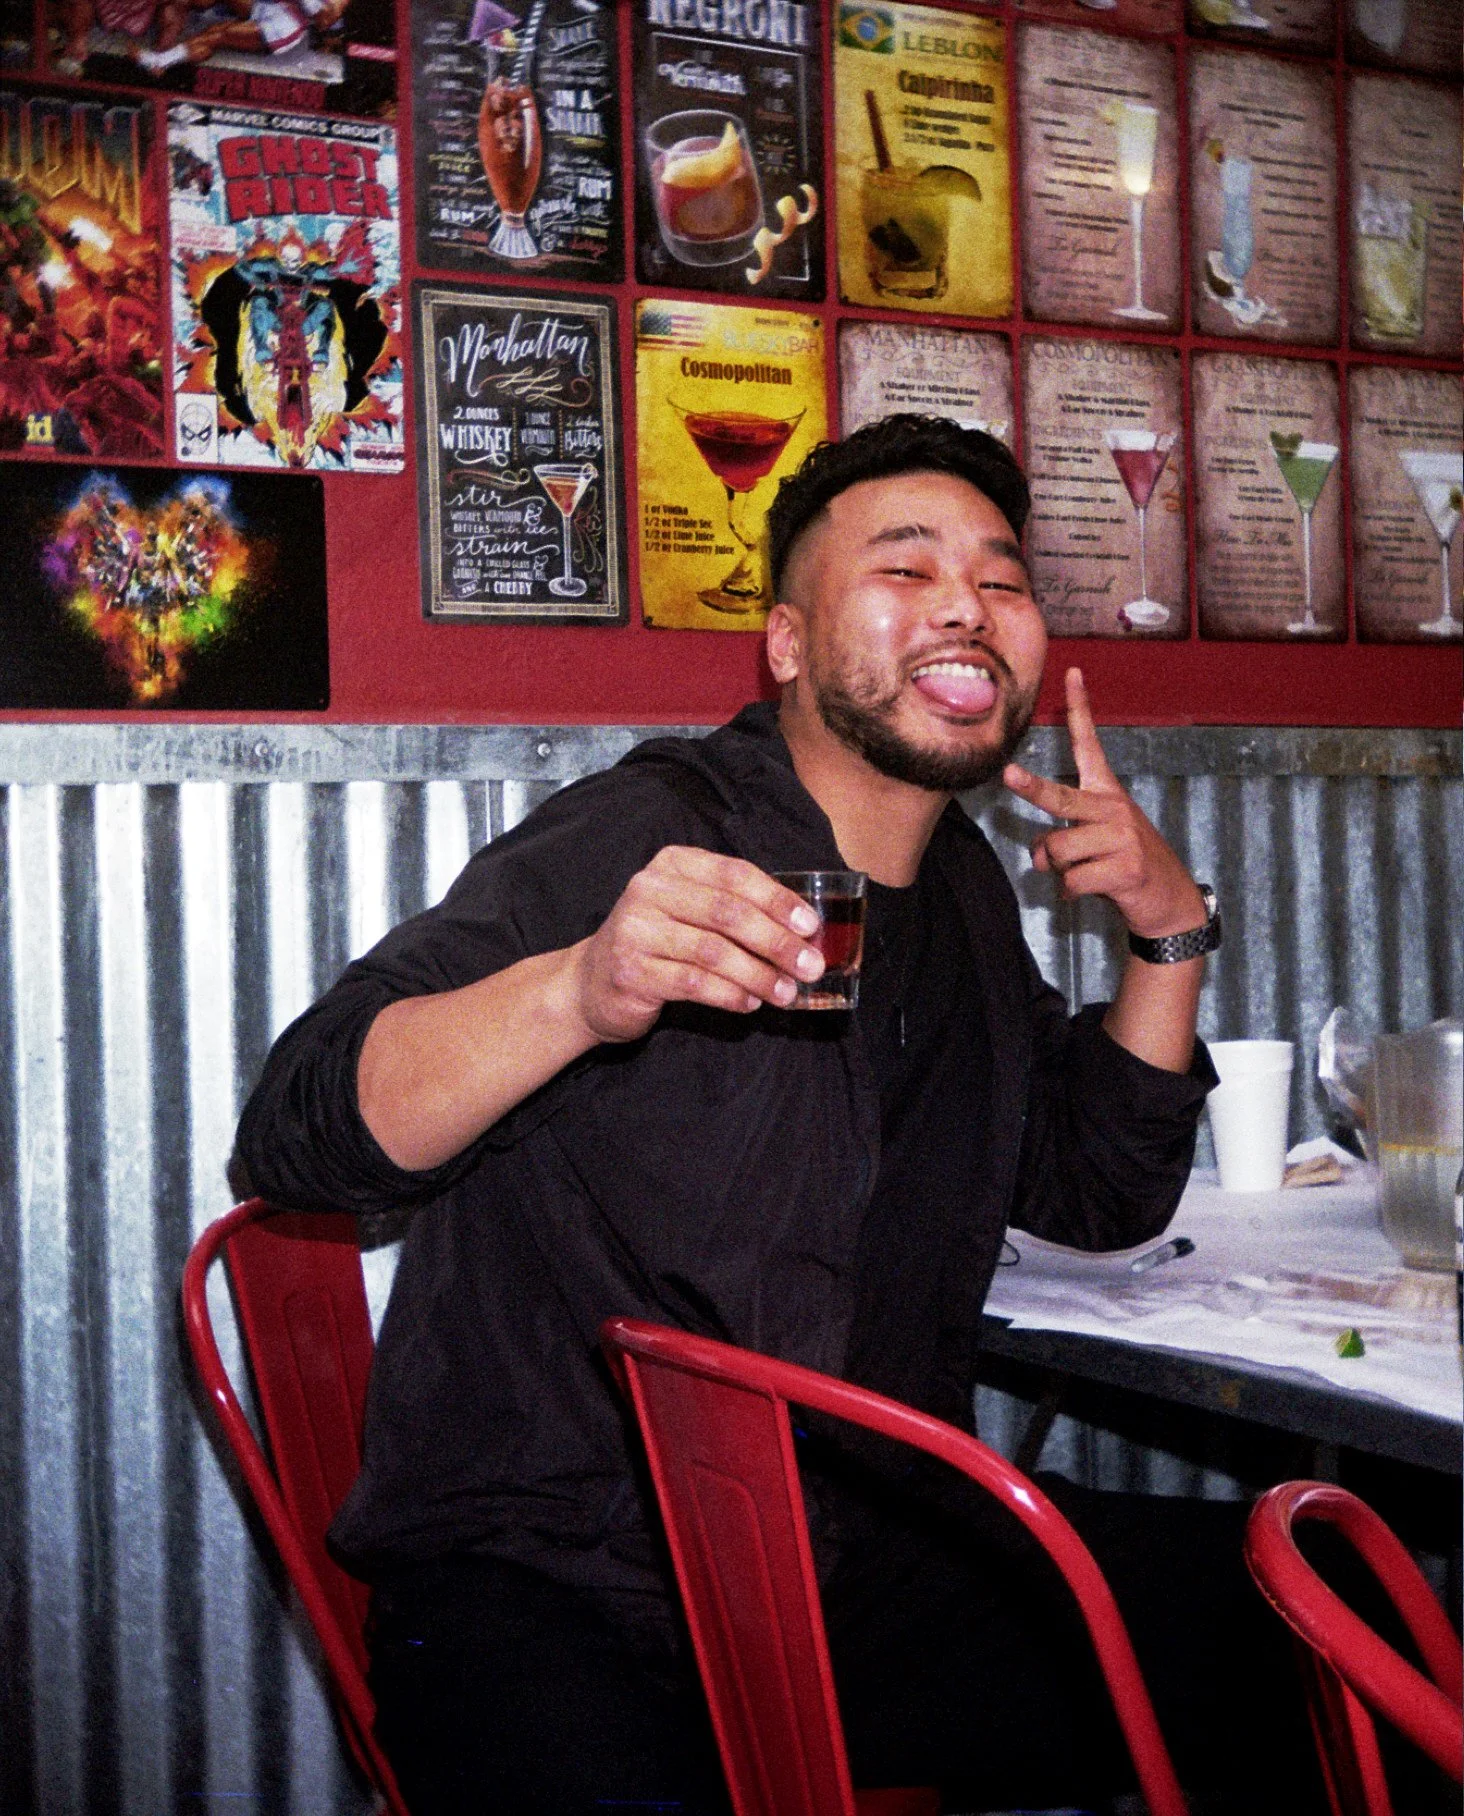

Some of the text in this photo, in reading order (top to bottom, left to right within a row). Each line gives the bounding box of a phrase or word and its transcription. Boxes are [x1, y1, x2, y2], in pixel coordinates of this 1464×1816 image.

[210, 109, 380, 139] MARVEL COMICS GROUP
[217, 134, 382, 181] GHOST
[579, 176, 612, 200] RUM
[224, 175, 393, 224] RIDER
[440, 208, 475, 221] RUM
[439, 312, 593, 397] Manhattan
[680, 356, 792, 386] Cosmopolitan
[453, 406, 464, 420] 2
[26, 412, 54, 445] id
[439, 423, 513, 452] WHISKEY
[453, 522, 491, 534] BITTERS
[525, 524, 559, 535] ice
[645, 517, 660, 527] 1/2
[673, 517, 698, 530] Triple
[645, 529, 660, 539] 1/2
[444, 535, 561, 556] strain
[645, 542, 660, 552] 1/2
[673, 542, 713, 555] Cranberry
[484, 582, 490, 593] A
